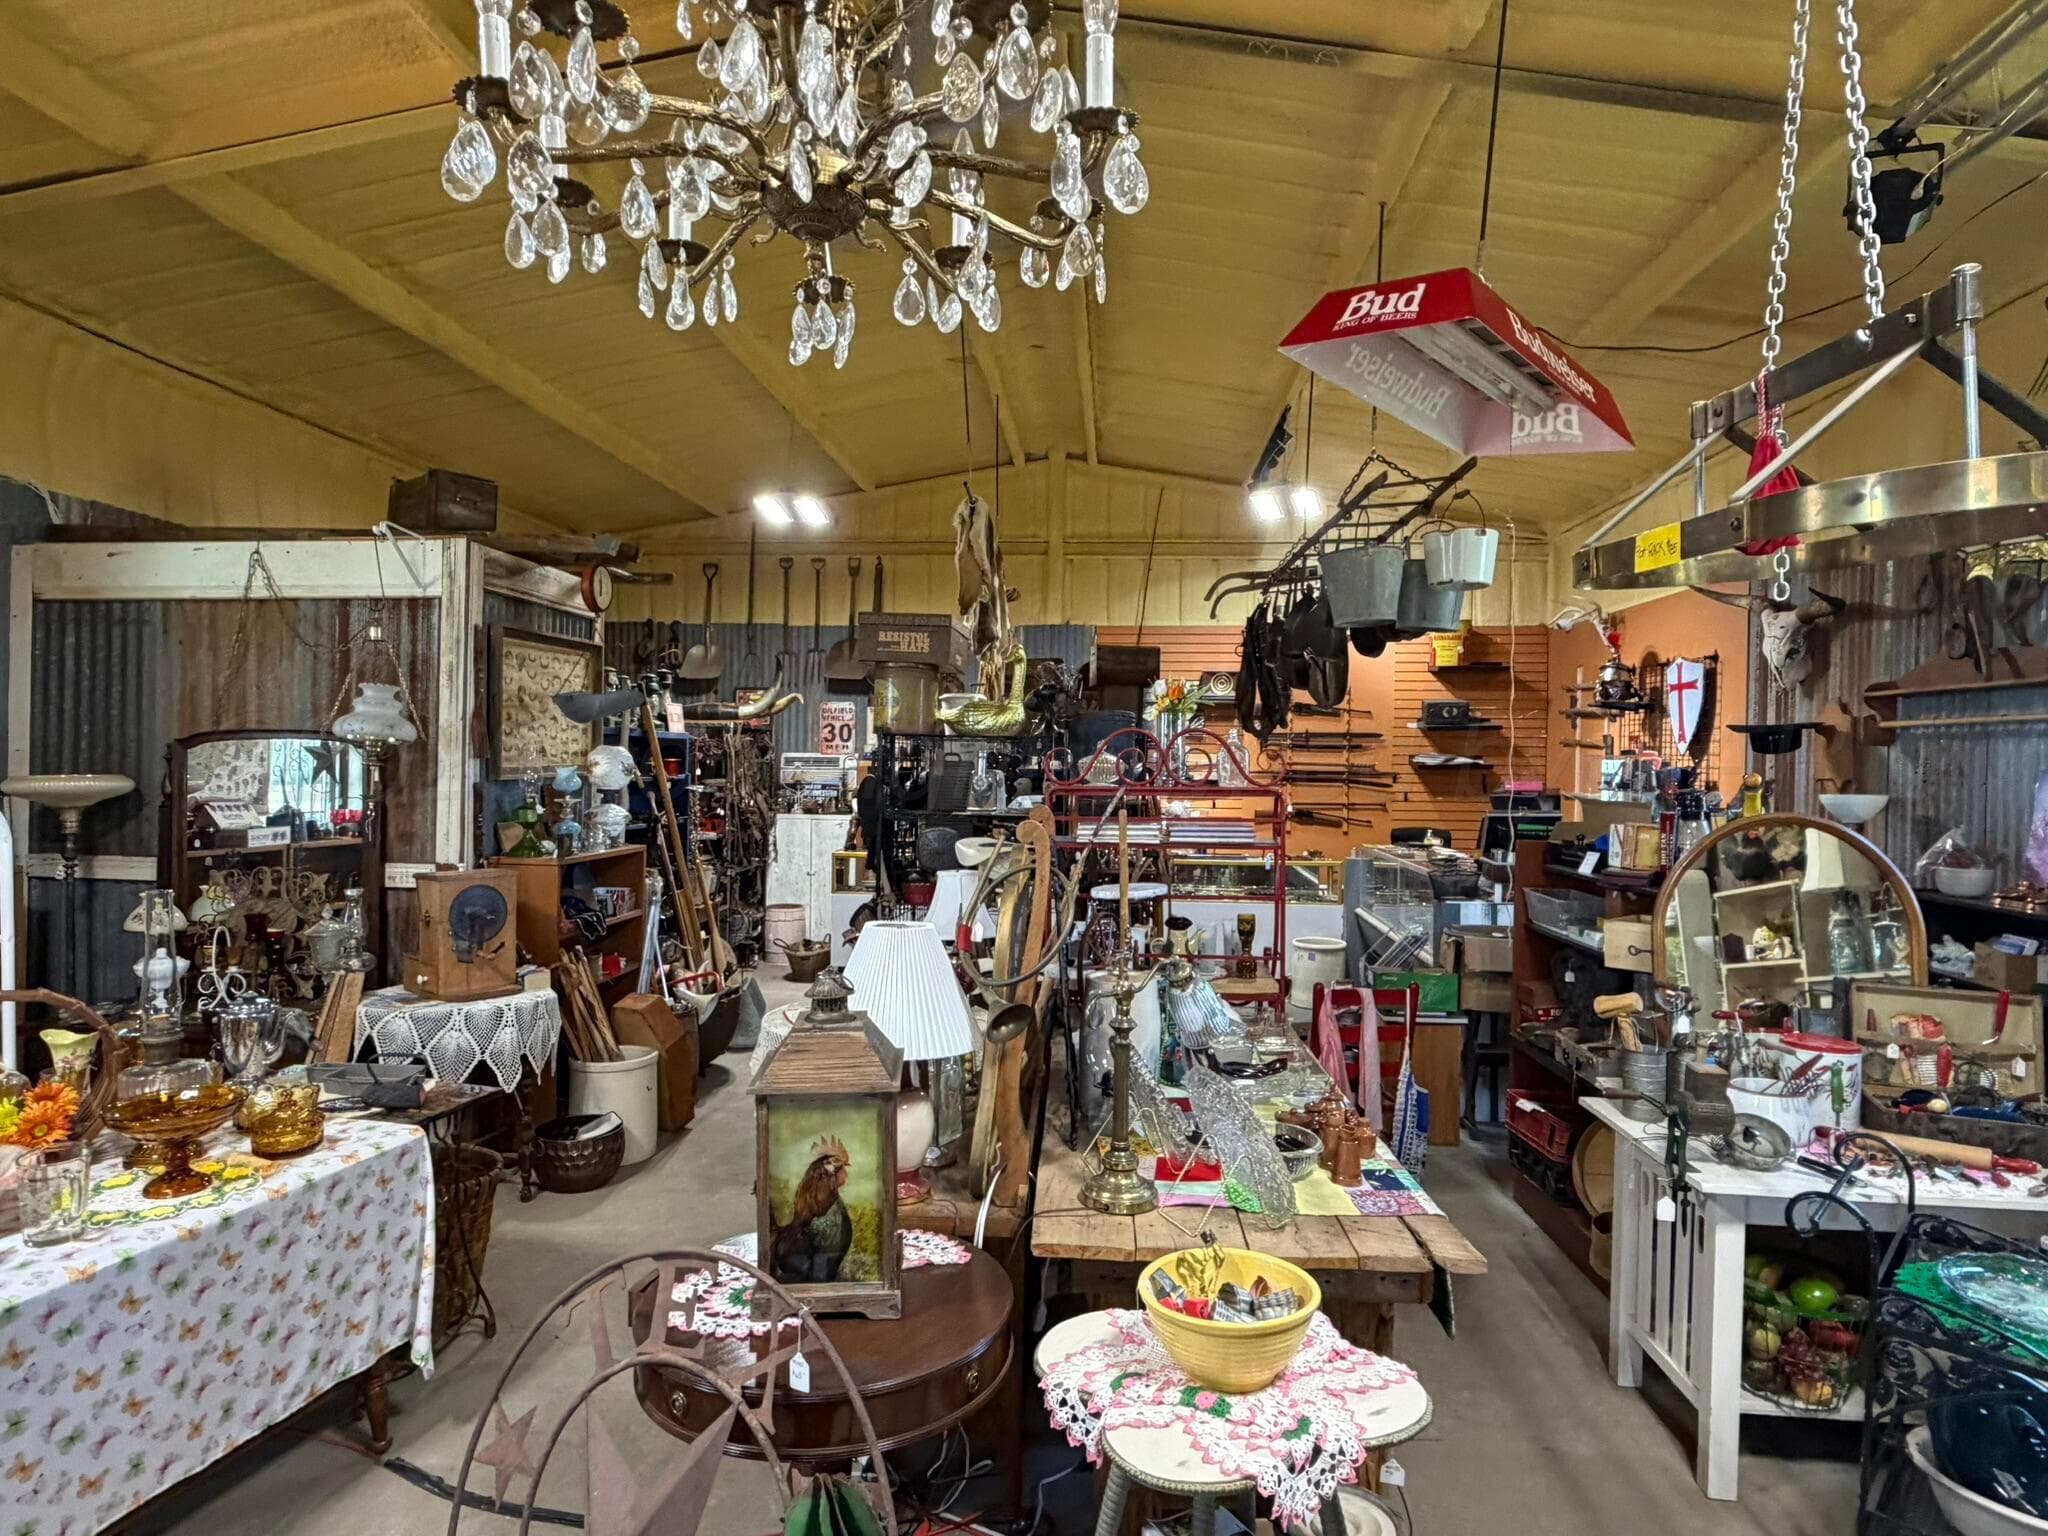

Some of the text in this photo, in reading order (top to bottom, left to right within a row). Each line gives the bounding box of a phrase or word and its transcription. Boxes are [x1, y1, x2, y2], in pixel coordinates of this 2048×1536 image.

[1334, 282, 1427, 325] Bud
[1331, 311, 1418, 333] KING OF BEERS
[1505, 307, 1598, 404] Budweiser
[878, 631, 930, 642] RESISTOL
[899, 640, 930, 653] HATS
[821, 706, 854, 715] OILFIELD
[822, 723, 852, 743] 30
